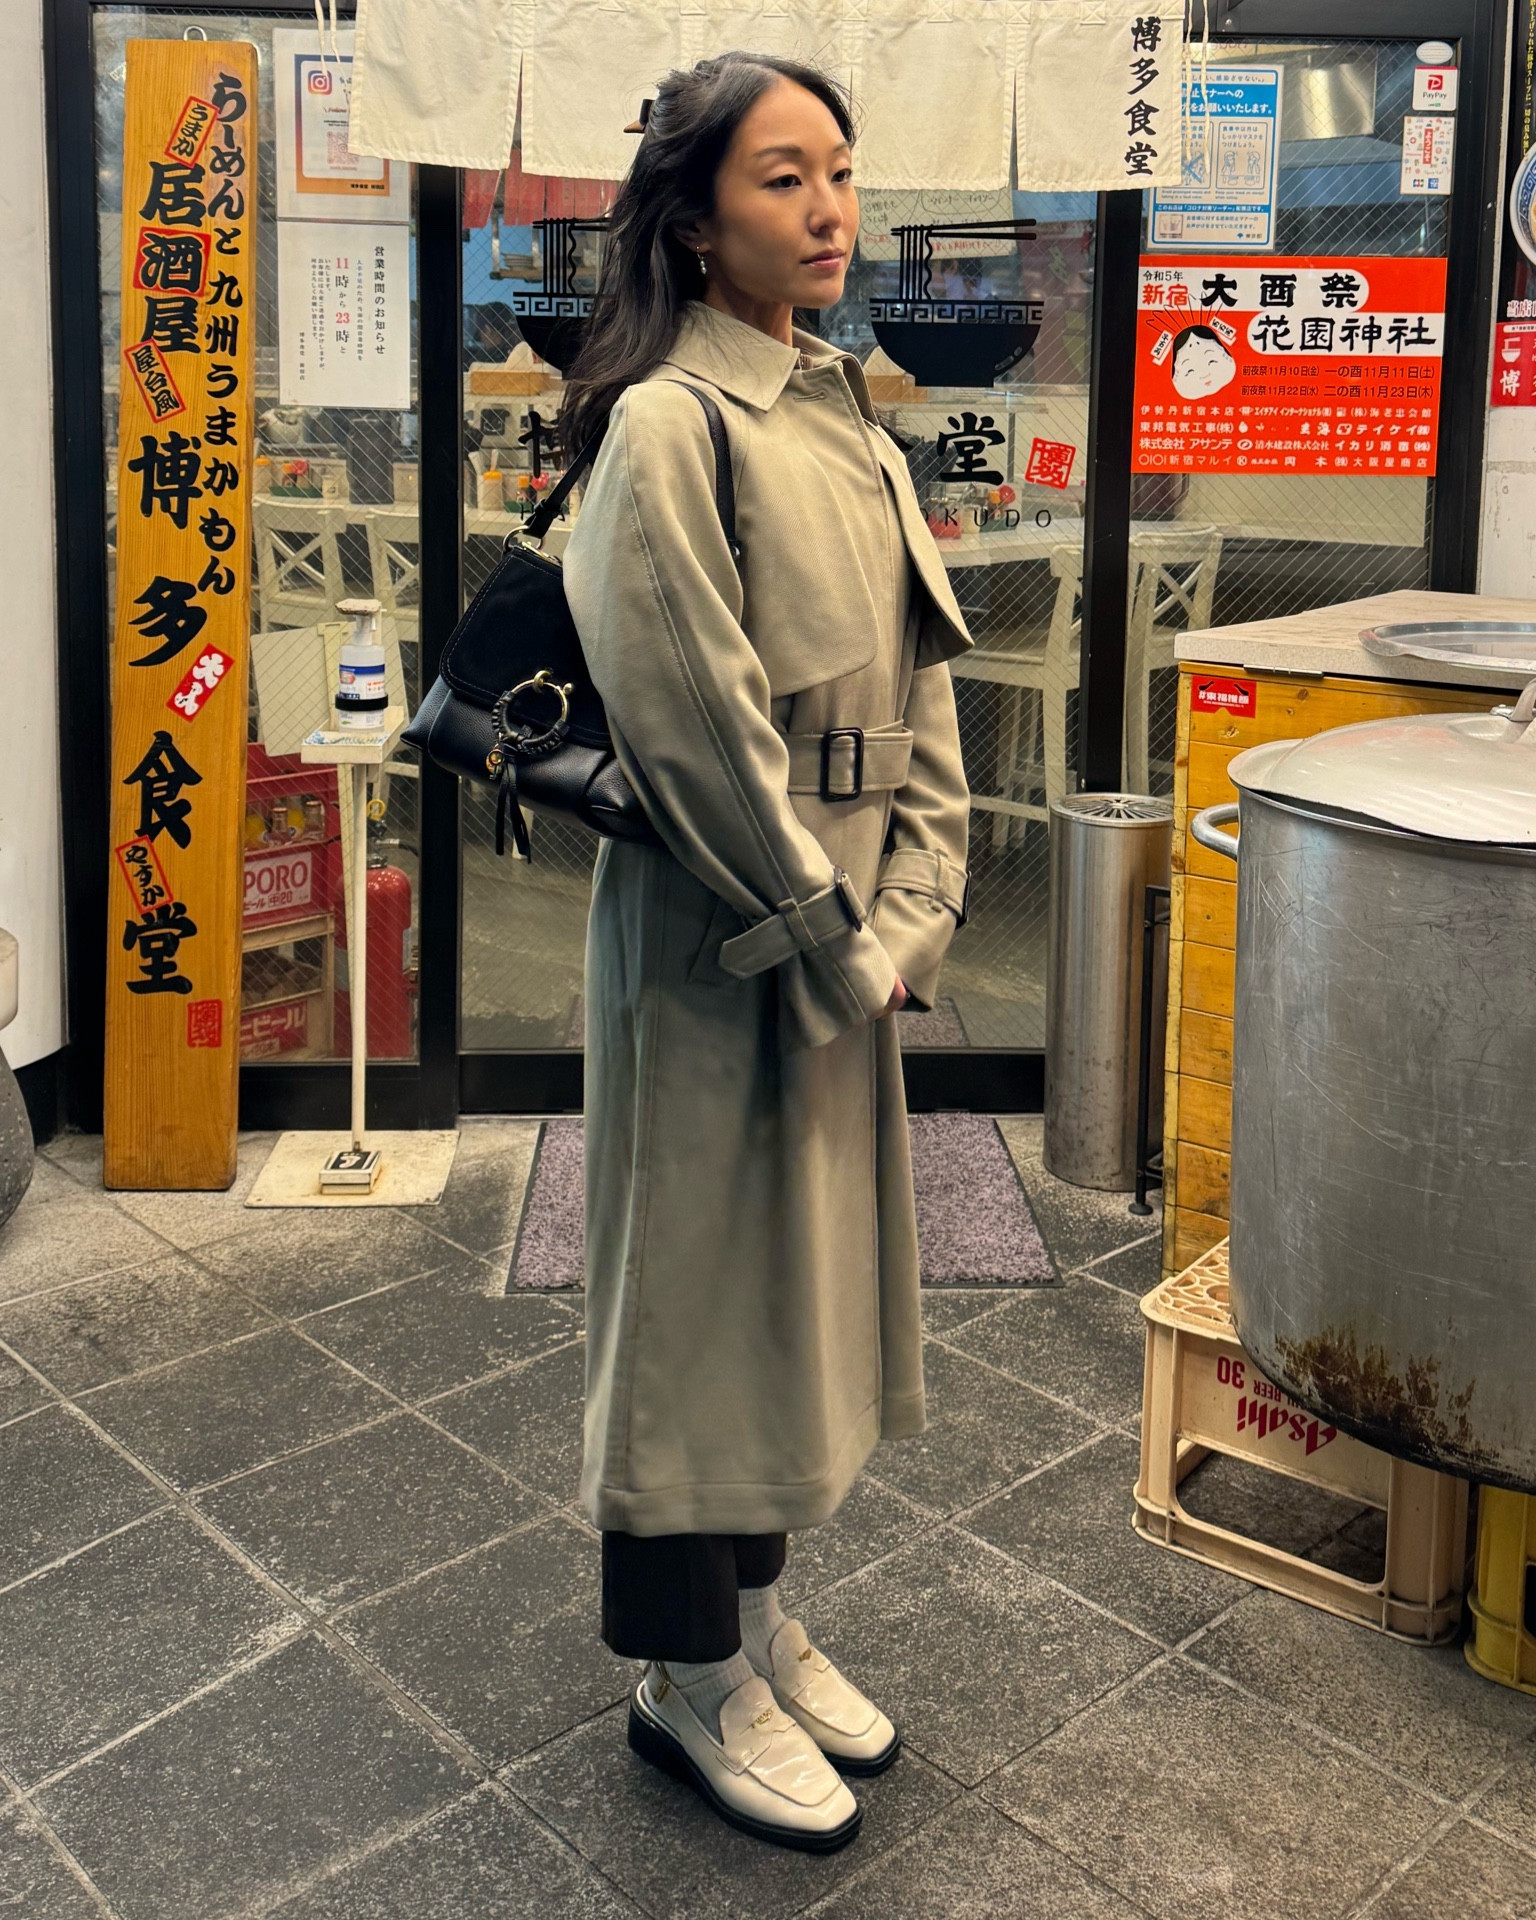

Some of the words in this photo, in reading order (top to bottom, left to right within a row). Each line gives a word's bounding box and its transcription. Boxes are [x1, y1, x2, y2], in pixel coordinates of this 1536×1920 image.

[1124, 17, 1162, 177] 博多食堂
[1422, 91, 1447, 99] PayPay
[172, 102, 209, 158] うまか
[1143, 270, 1183, 281] 令和5年
[335, 257, 350, 354] 11時から23時と
[374, 246, 385, 355] 営業時間のお知らせ
[1142, 283, 1189, 307] 新宿
[1252, 315, 1436, 354] 花園神社
[132, 344, 181, 418] 屋台風
[1141, 405, 1235, 416] 伊勢丹新宿本店
[1139, 437, 1185, 450] 株式会社
[1189, 438, 1233, 450] アサンテ
[1255, 440, 1329, 451] 清水建設株式会社
[1169, 455, 1232, 466] 新宿マルイ
[921, 507, 1051, 529] KUDO
[125, 844, 165, 908] やすか
[1217, 1356, 1245, 1389] 30
[1254, 1380, 1282, 1403] BEER
[1237, 1396, 1337, 1456] Asahi
